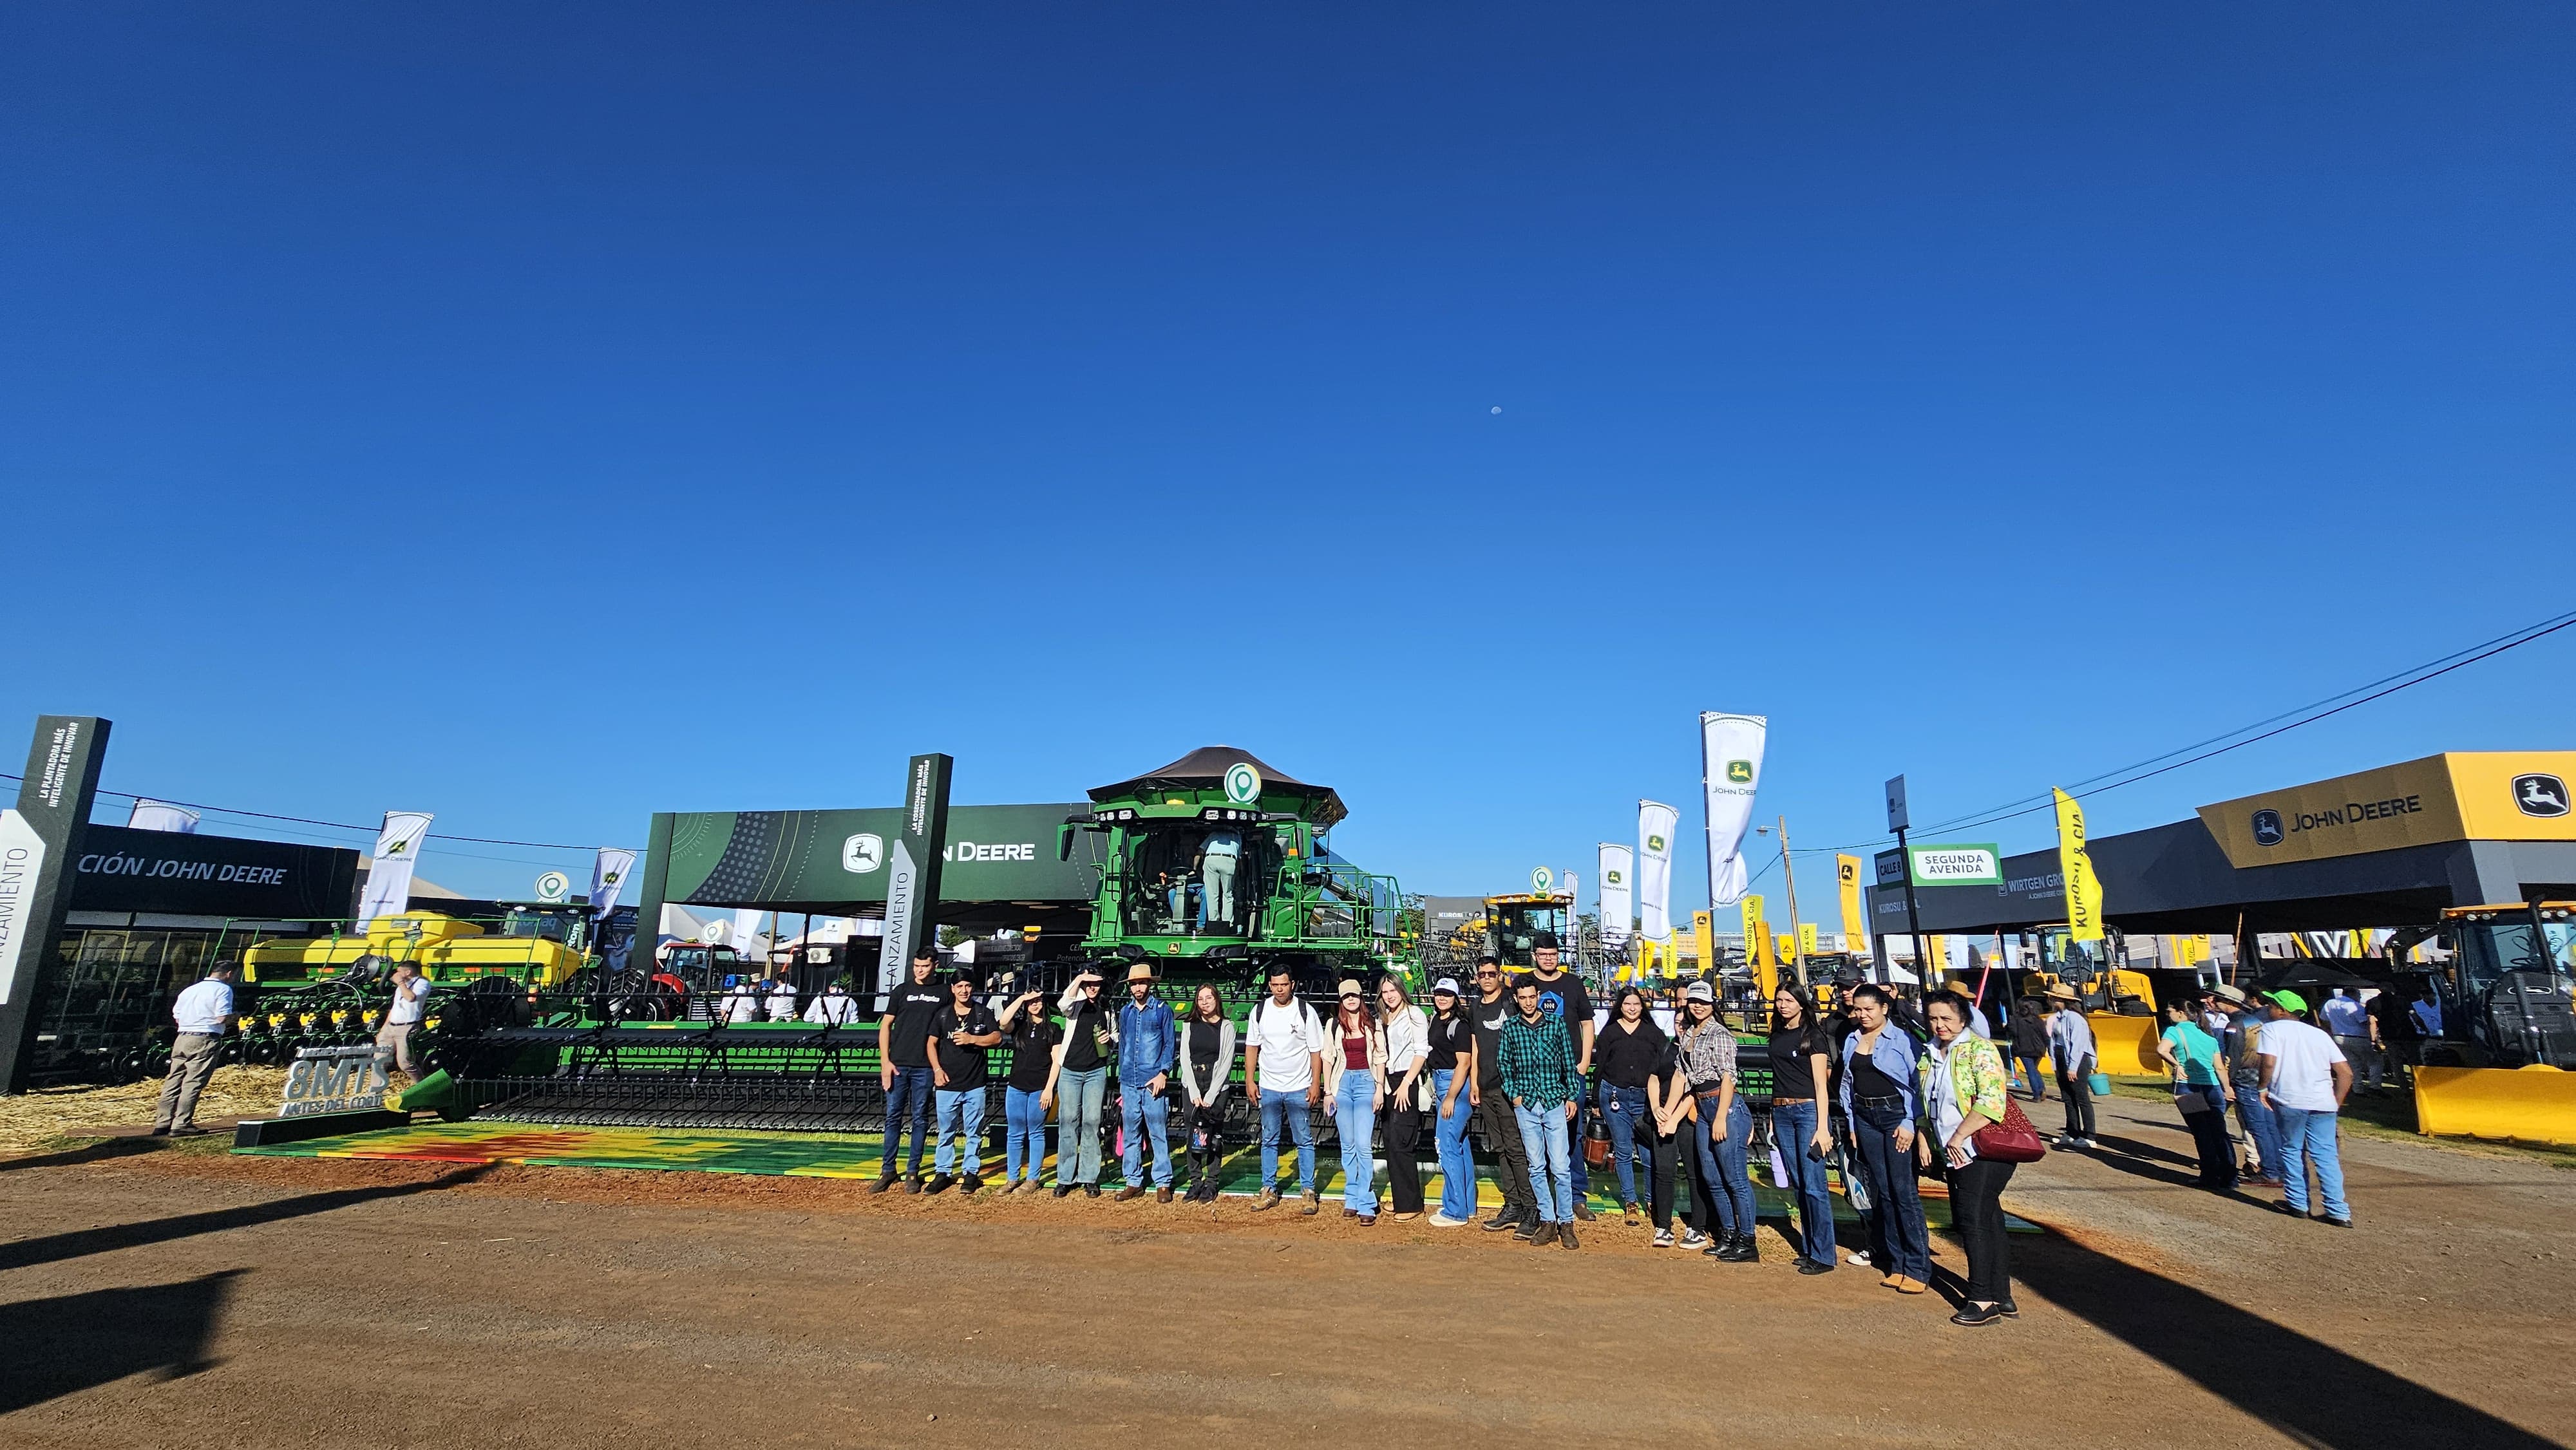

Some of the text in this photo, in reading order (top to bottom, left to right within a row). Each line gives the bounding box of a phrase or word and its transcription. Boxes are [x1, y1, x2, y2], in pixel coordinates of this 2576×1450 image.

[39, 728, 66, 798] LA PLANTADORA MÁS
[48, 722, 79, 807] INTELIGENTE DE INNOVAR
[913, 779, 922, 822] COSECHADORA
[921, 787, 927, 796] DE
[1713, 786, 1736, 795] JOHN
[917, 796, 926, 836] INTELIGENTE
[2291, 795, 2422, 832] JOHN DEERE
[912, 822, 918, 831] LA
[958, 842, 1035, 862] DEERE
[1925, 854, 1984, 864] SEGUNDA
[2074, 846, 2083, 856] &
[78, 851, 287, 885] CIÓN JOHN DEERE
[1880, 862, 1897, 876] CALLE
[1929, 864, 1983, 874] AVENIDA
[2008, 872, 2065, 892] WIRTGEN GRO
[1879, 901, 1901, 914] KUROSU
[885, 872, 908, 987] LANZAMIENTO
[285, 1057, 393, 1100] 8MTS
